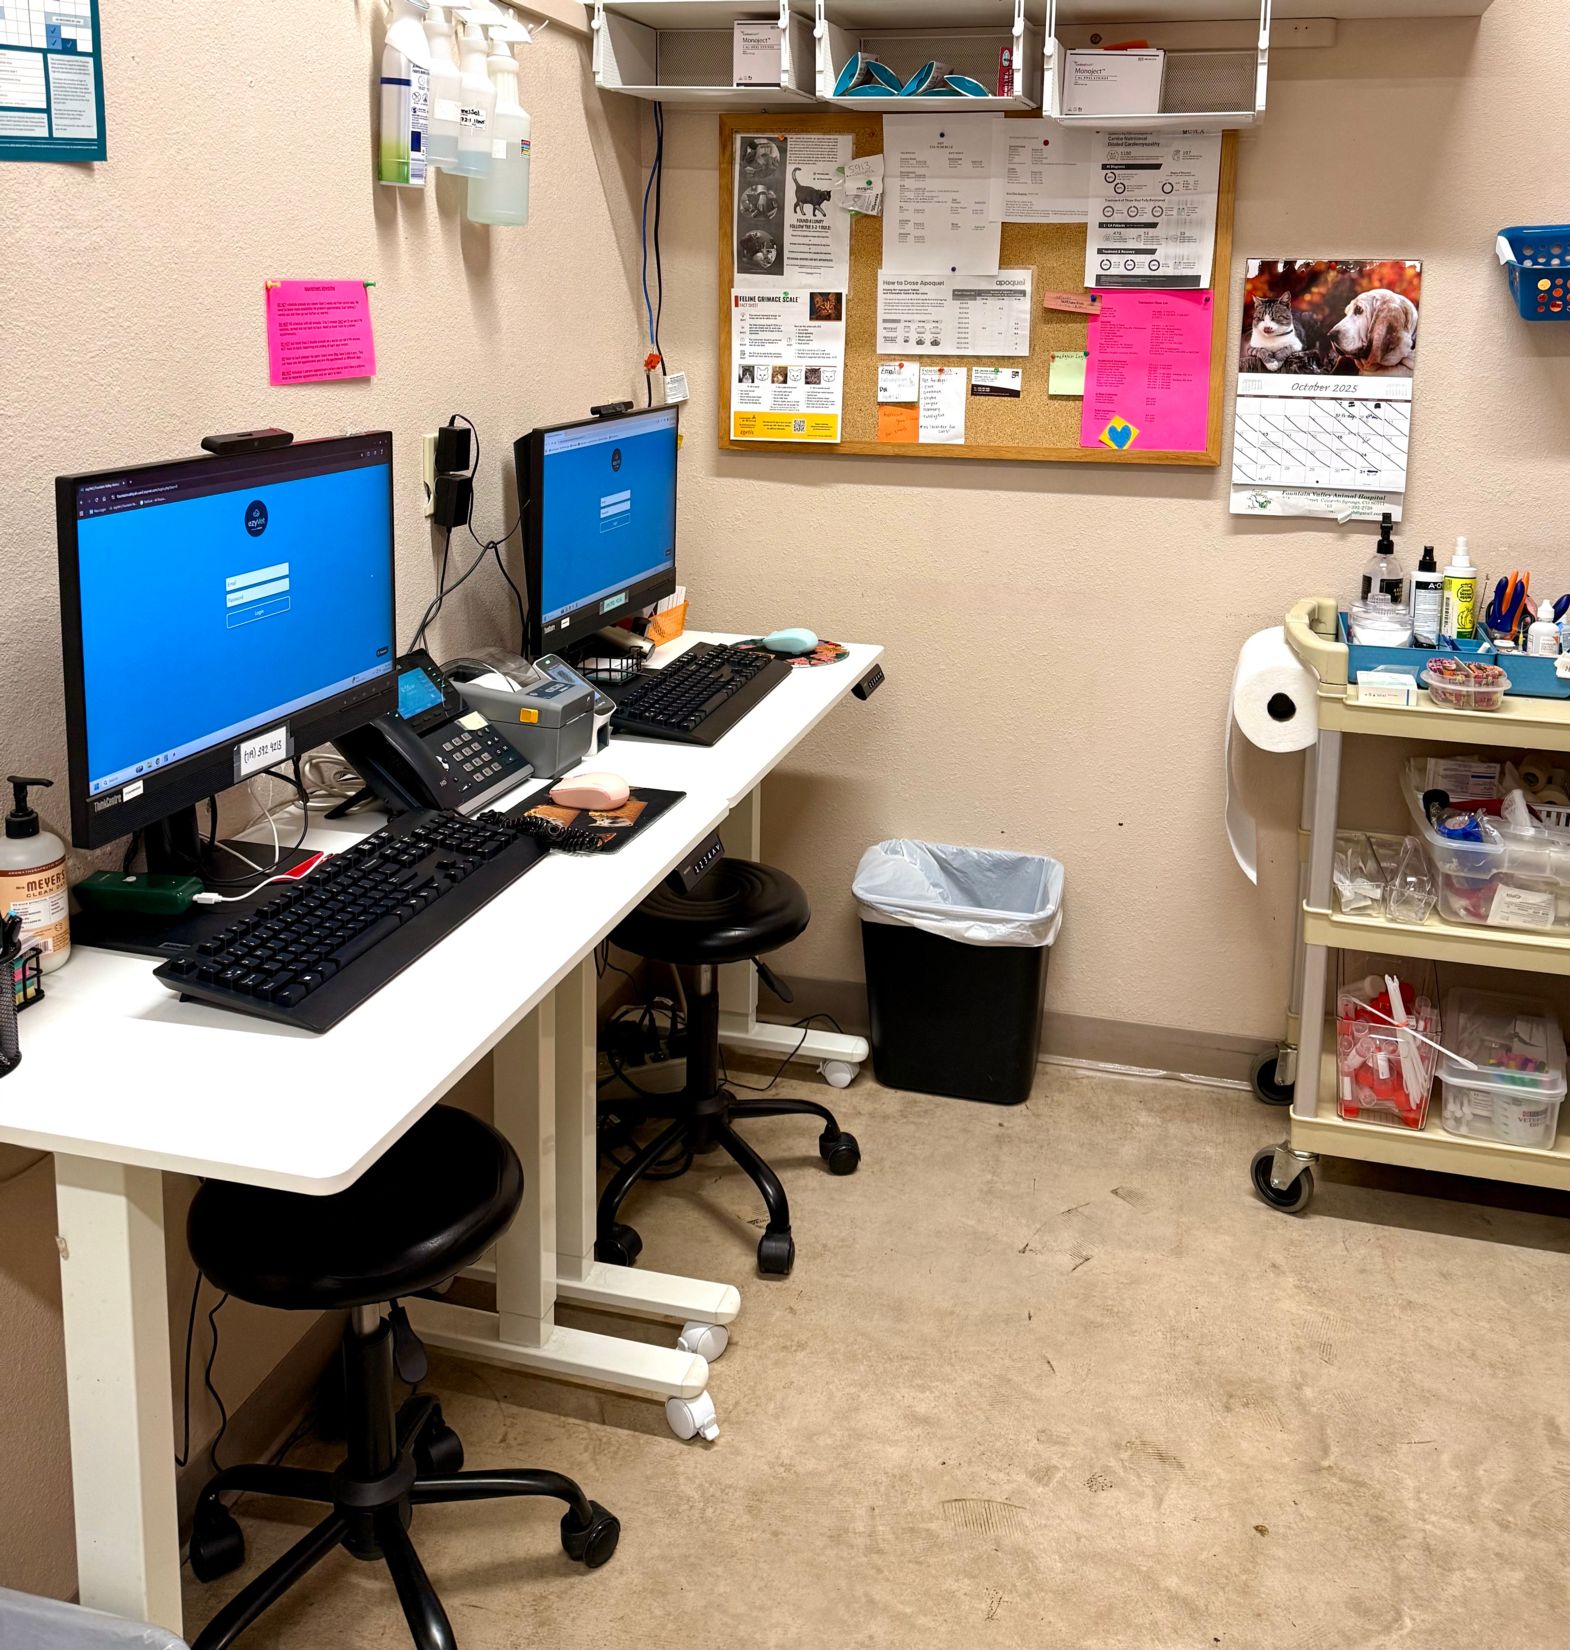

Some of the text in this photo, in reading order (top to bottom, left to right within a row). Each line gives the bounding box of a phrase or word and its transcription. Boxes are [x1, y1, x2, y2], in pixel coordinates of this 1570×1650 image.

[1292, 382, 1359, 393] October 2025
[248, 517, 266, 527] ezyVet
[27, 870, 65, 892] MEYER'S
[26, 888, 54, 898] CLEAN
